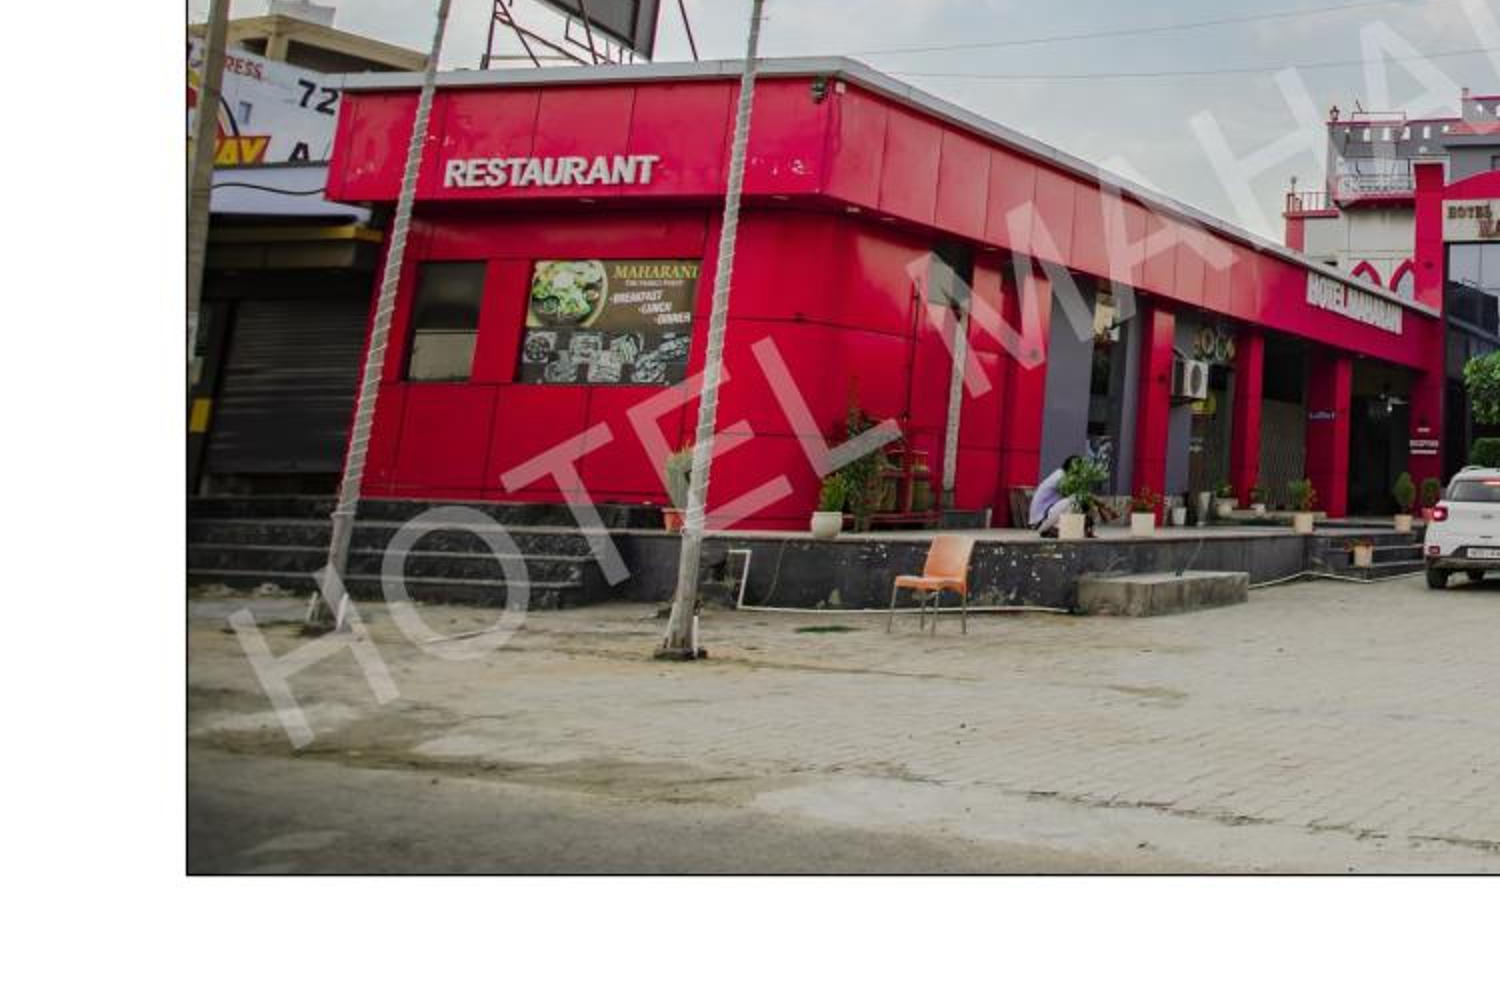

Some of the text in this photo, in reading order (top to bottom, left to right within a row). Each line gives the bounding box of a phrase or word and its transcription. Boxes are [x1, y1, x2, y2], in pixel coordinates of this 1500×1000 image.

[224, 55, 263, 81] RESS
[298, 79, 339, 116] 72
[443, 154, 660, 188] RESTAURANT
[612, 265, 698, 279] MAHARANI
